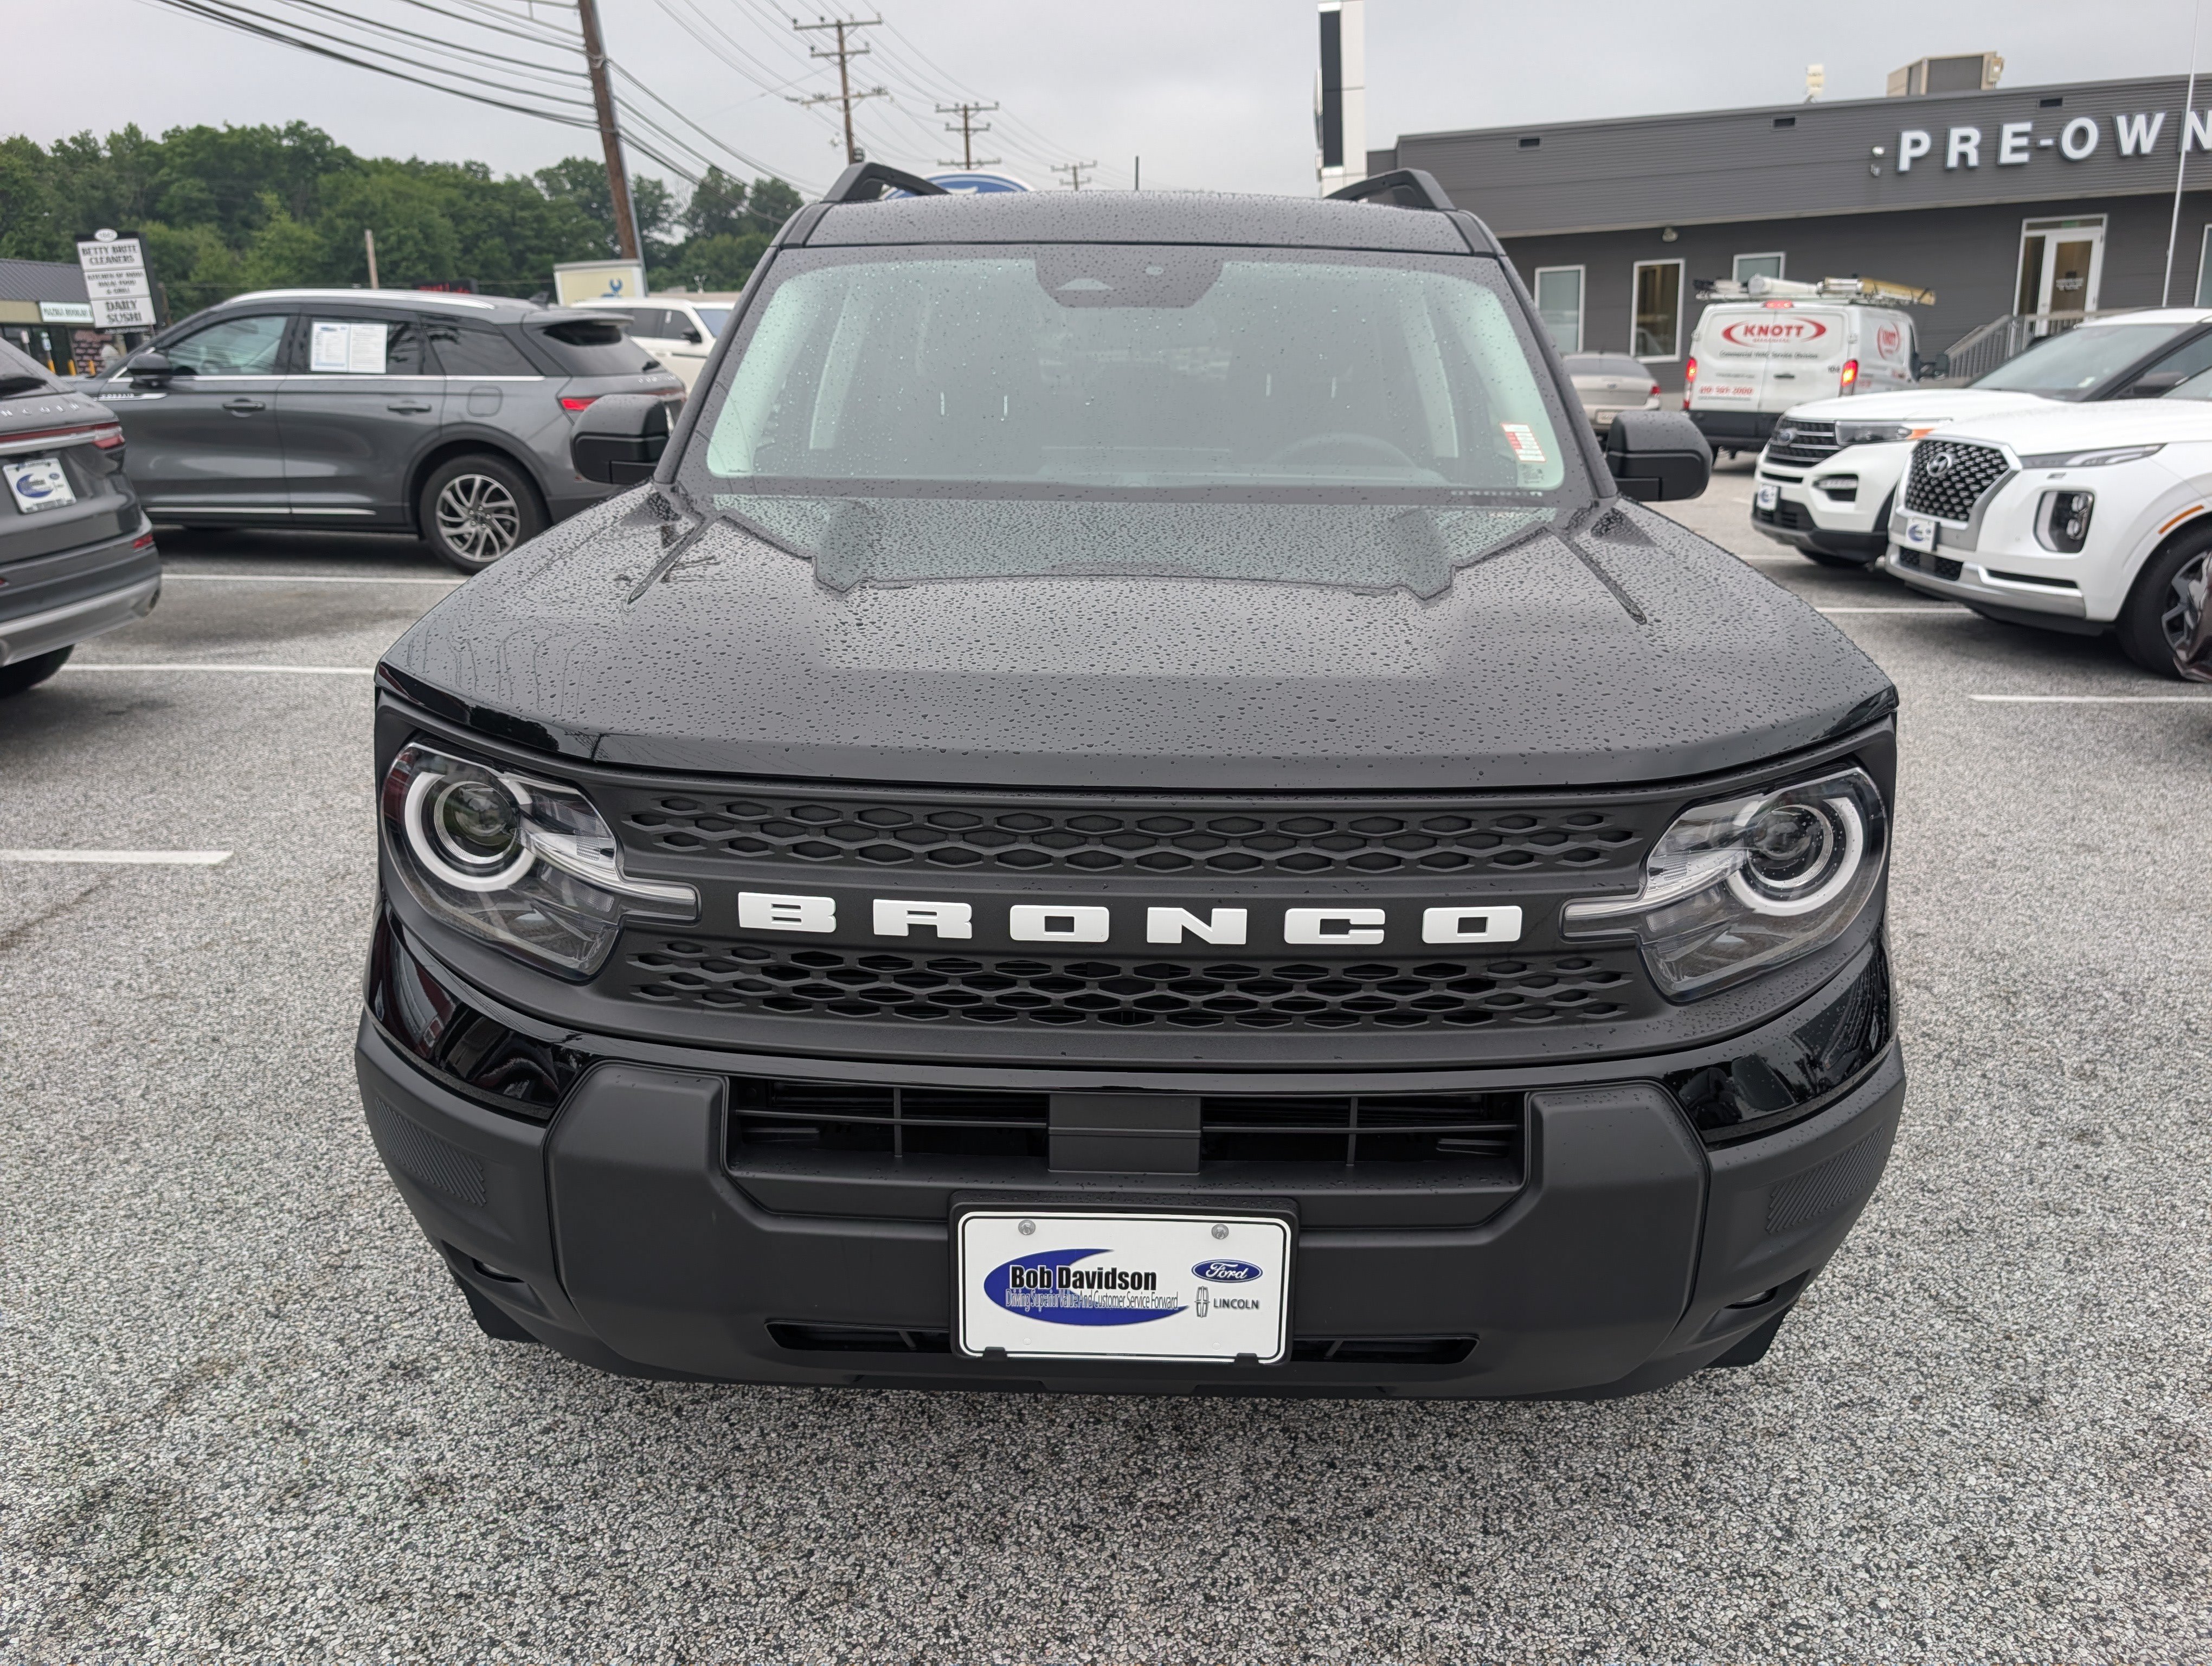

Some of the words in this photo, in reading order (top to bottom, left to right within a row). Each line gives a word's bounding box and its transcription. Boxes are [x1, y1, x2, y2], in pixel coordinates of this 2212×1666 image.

[82, 247, 108, 256] BETTY
[112, 245, 136, 253] BRITE
[89, 255, 135, 265] CLEANERS
[106, 299, 136, 312] DAILY
[107, 311, 143, 323] SUSHI
[1742, 324, 1804, 337] KNOTT
[737, 891, 1523, 944] BRONCO
[1205, 1262, 1249, 1279] Ford
[1010, 1265, 1052, 1290] Bob
[1057, 1265, 1157, 1290] Davidson
[1006, 1289, 1030, 1311] Driving
[1031, 1289, 1059, 1312] Superior
[1059, 1290, 1078, 1308] Value
[1079, 1290, 1093, 1308] And
[1094, 1291, 1126, 1309] Customer
[1126, 1291, 1150, 1309] Service
[1150, 1291, 1179, 1309] Forward
[1213, 1298, 1259, 1309] LINCOLN
